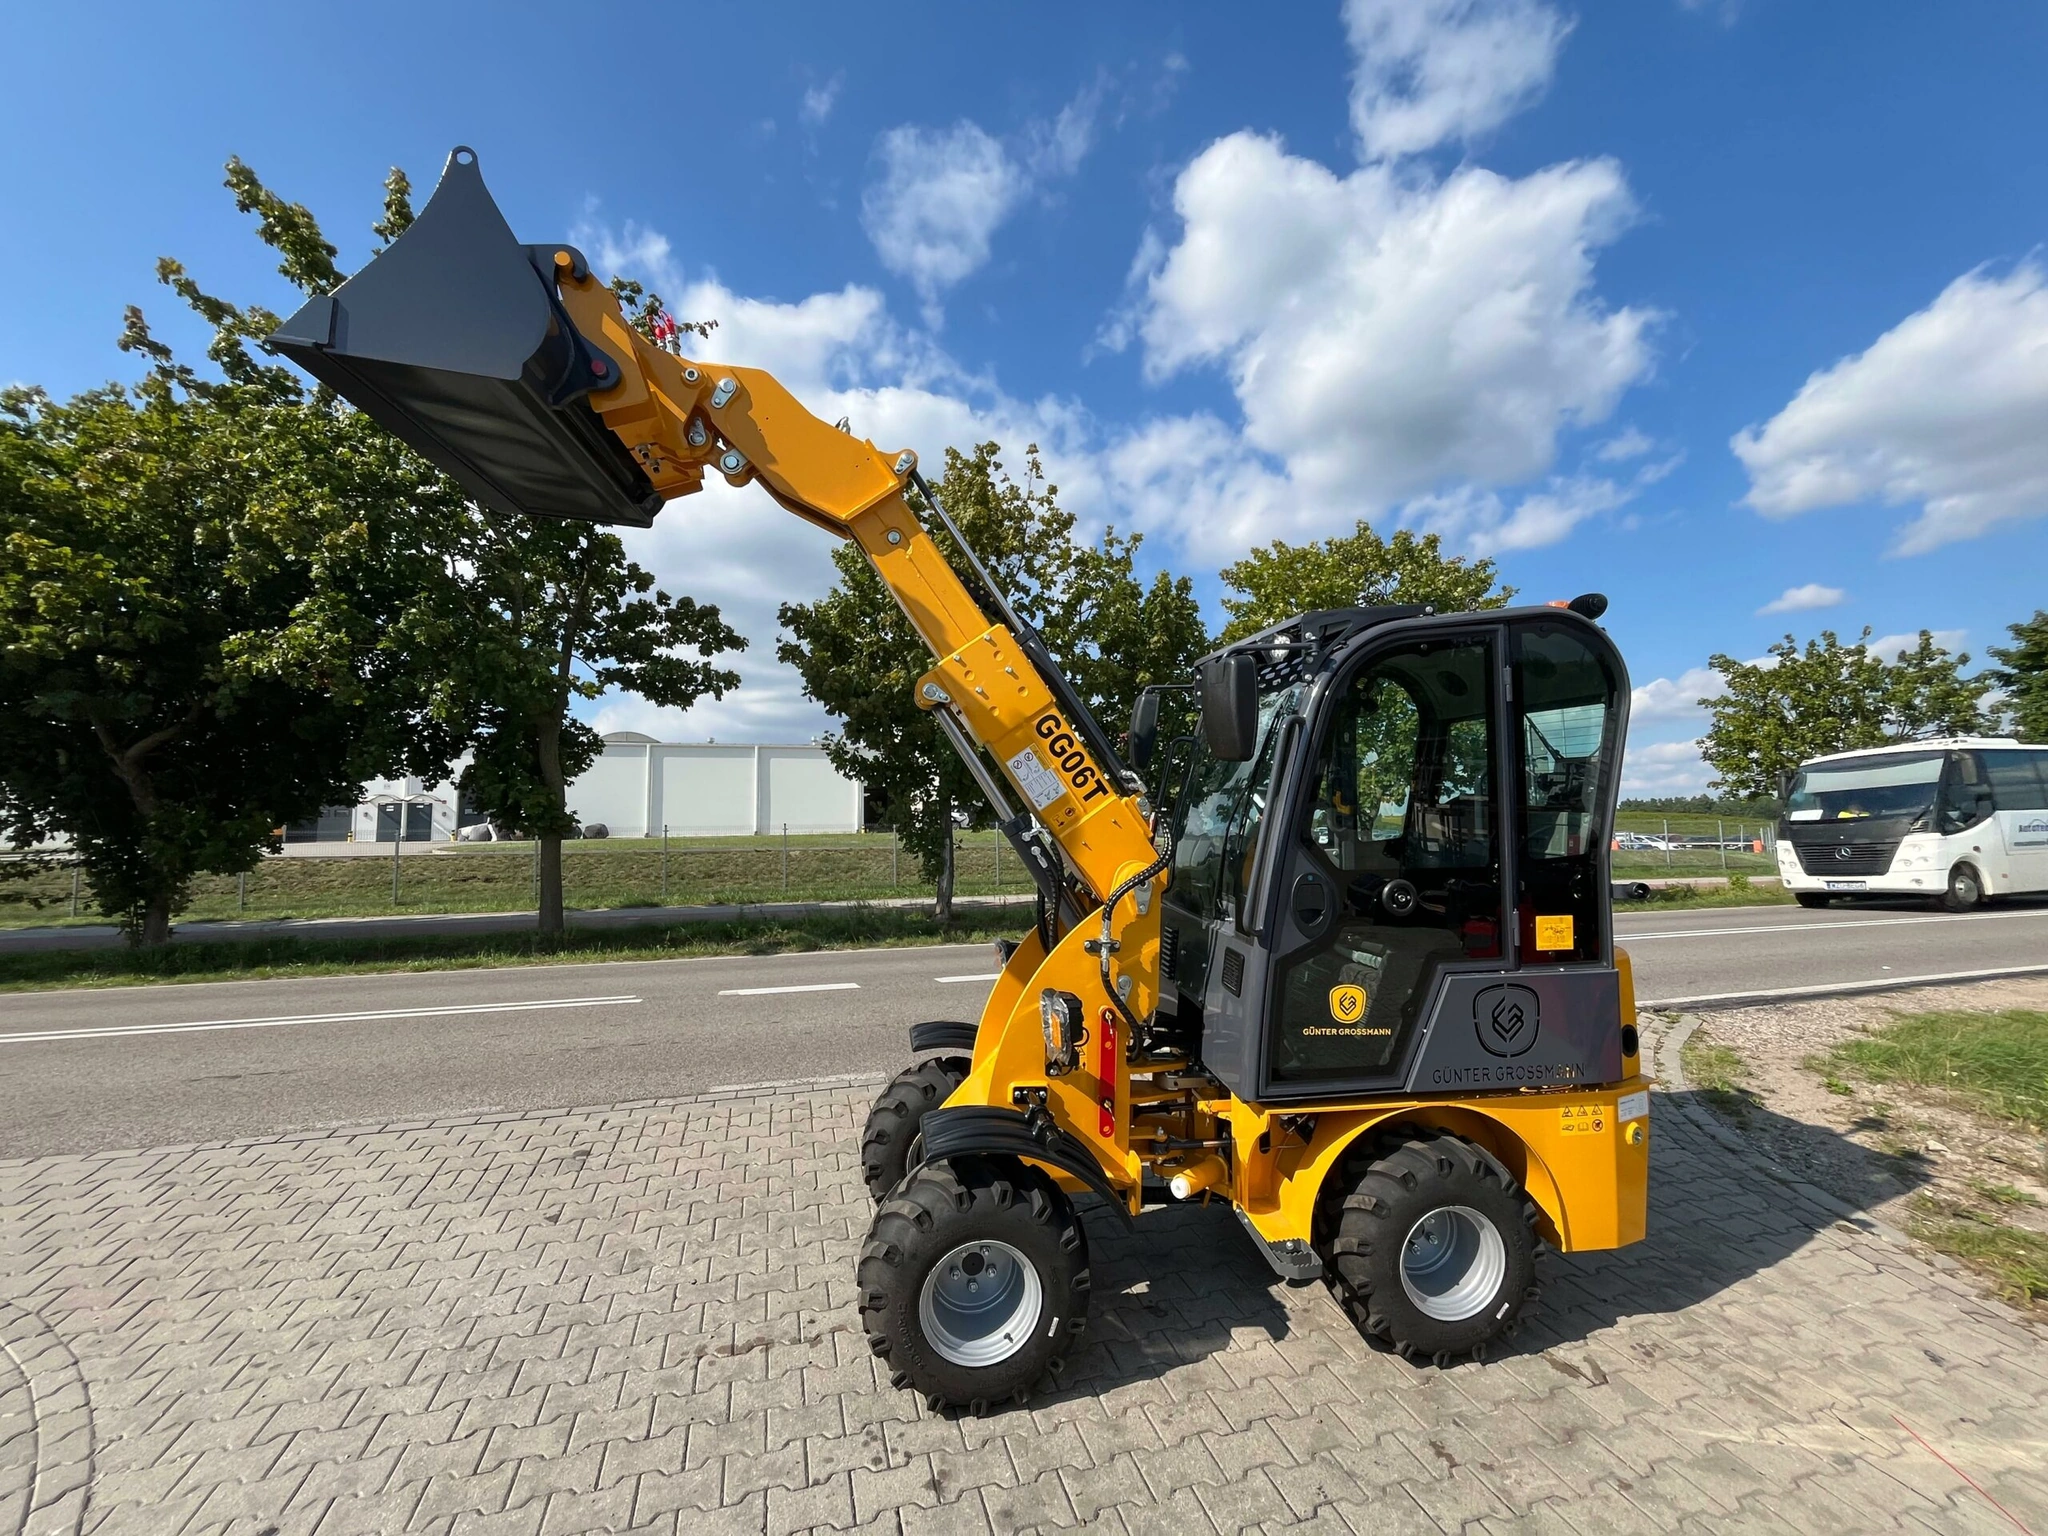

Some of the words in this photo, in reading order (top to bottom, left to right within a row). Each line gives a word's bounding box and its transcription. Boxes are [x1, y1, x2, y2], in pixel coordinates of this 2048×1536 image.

[1036, 714, 1109, 802] GG06T
[1302, 1026, 1338, 1036] GÜNTER
[1338, 1028, 1391, 1036] GROSSMANN
[1432, 1066, 1491, 1085] GÜNTER
[1495, 1063, 1585, 1082] GROSSMANN
